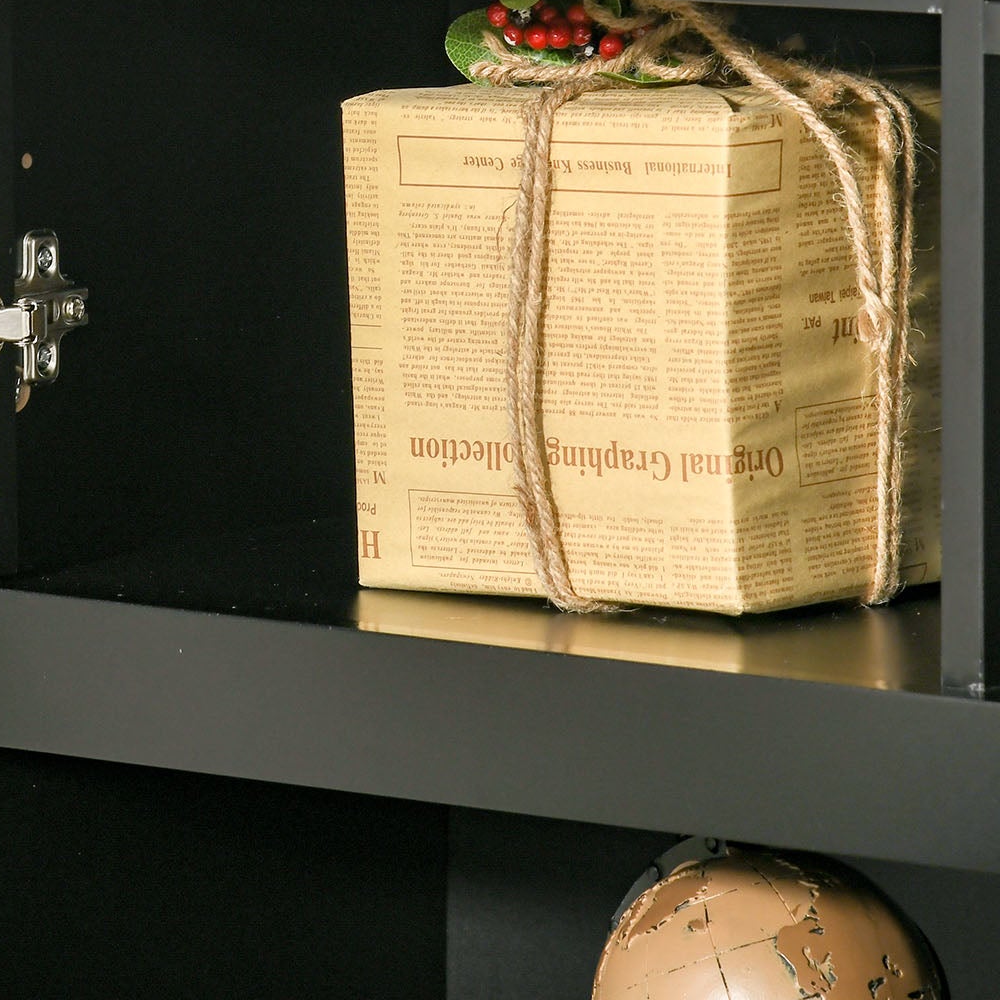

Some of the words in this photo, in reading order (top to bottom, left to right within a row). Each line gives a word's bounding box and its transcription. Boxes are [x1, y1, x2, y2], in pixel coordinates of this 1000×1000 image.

[462, 156, 504, 171] Center
[578, 160, 632, 175] Business
[644, 162, 732, 178] International
[809, 290, 836, 304] Taiwan
[801, 315, 822, 330] PAT.
[410, 437, 514, 470] ollection
[546, 437, 671, 481] Graphing
[680, 444, 784, 482] Original
